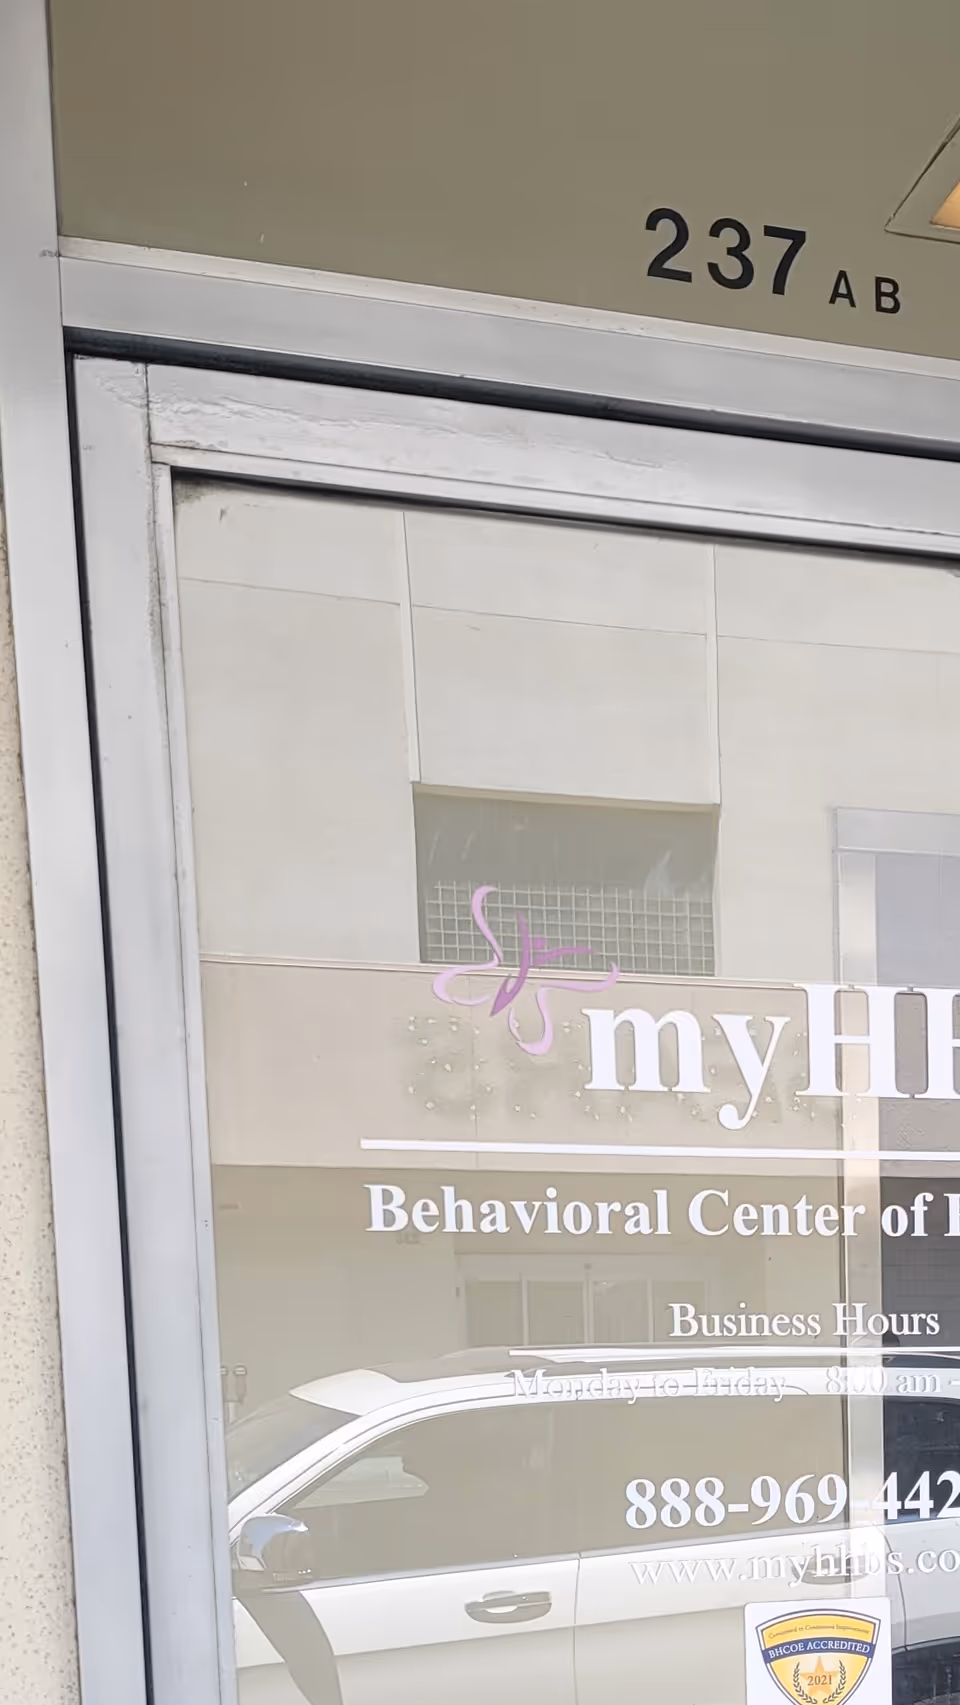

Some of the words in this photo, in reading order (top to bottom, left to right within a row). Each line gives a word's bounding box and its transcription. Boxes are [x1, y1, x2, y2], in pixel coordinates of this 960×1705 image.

[645, 207, 808, 296] 237
[363, 1184, 672, 1236] Behavioral
[688, 1189, 866, 1237] Center
[881, 1193, 934, 1238] of
[668, 1303, 822, 1338] Business
[832, 1303, 941, 1336] Hours
[511, 1368, 641, 1405] Monday
[652, 1371, 685, 1398] to
[693, 1366, 786, 1402] Friday
[896, 1372, 941, 1393] am
[769, 1642, 805, 1659] BHCOE
[806, 1640, 870, 1654] ACCREDITED
[807, 1675, 833, 1686] 2021
